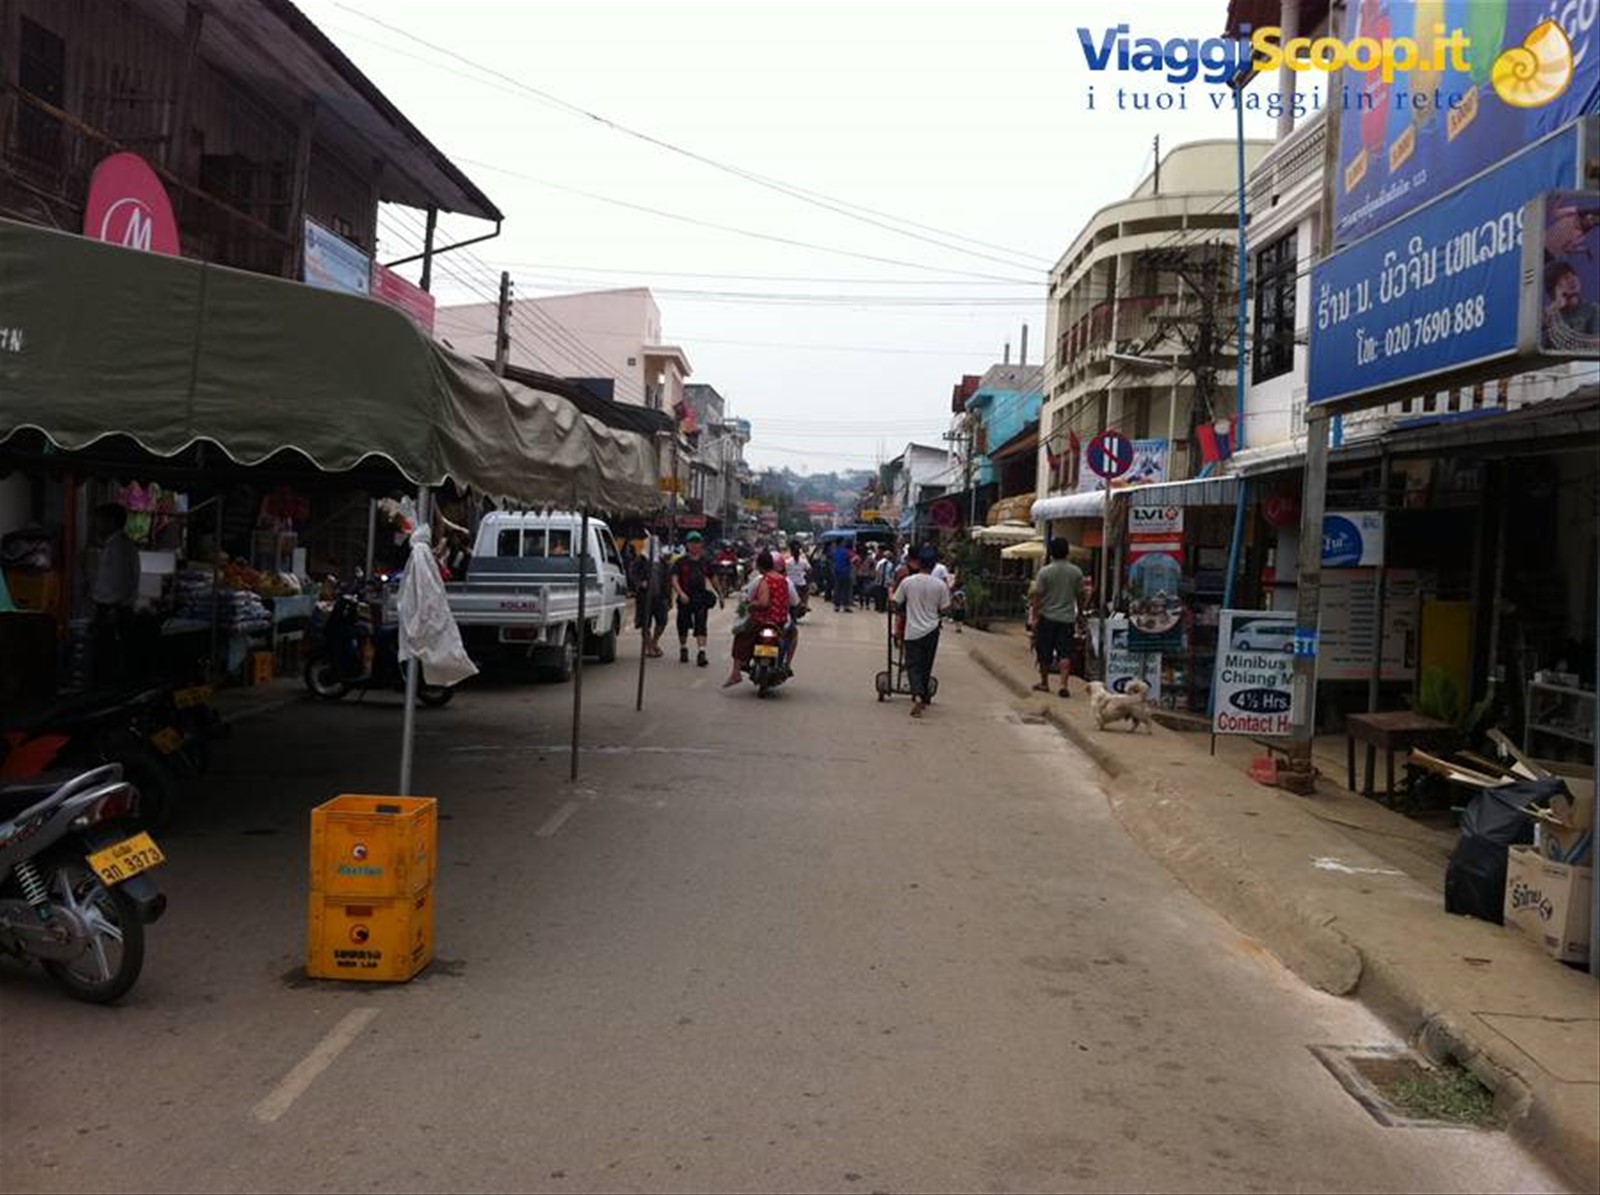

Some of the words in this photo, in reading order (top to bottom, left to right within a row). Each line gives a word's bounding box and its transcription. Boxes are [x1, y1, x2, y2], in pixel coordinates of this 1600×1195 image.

[1385, 323, 1410, 356] 020
[1414, 307, 1450, 348] 7690
[1454, 295, 1485, 334] 888
[1225, 654, 1286, 670] Minibus
[1222, 669, 1276, 686] Chiang
[1282, 672, 1294, 685] M
[1218, 711, 1272, 732] Contact
[1277, 714, 1292, 732] H
